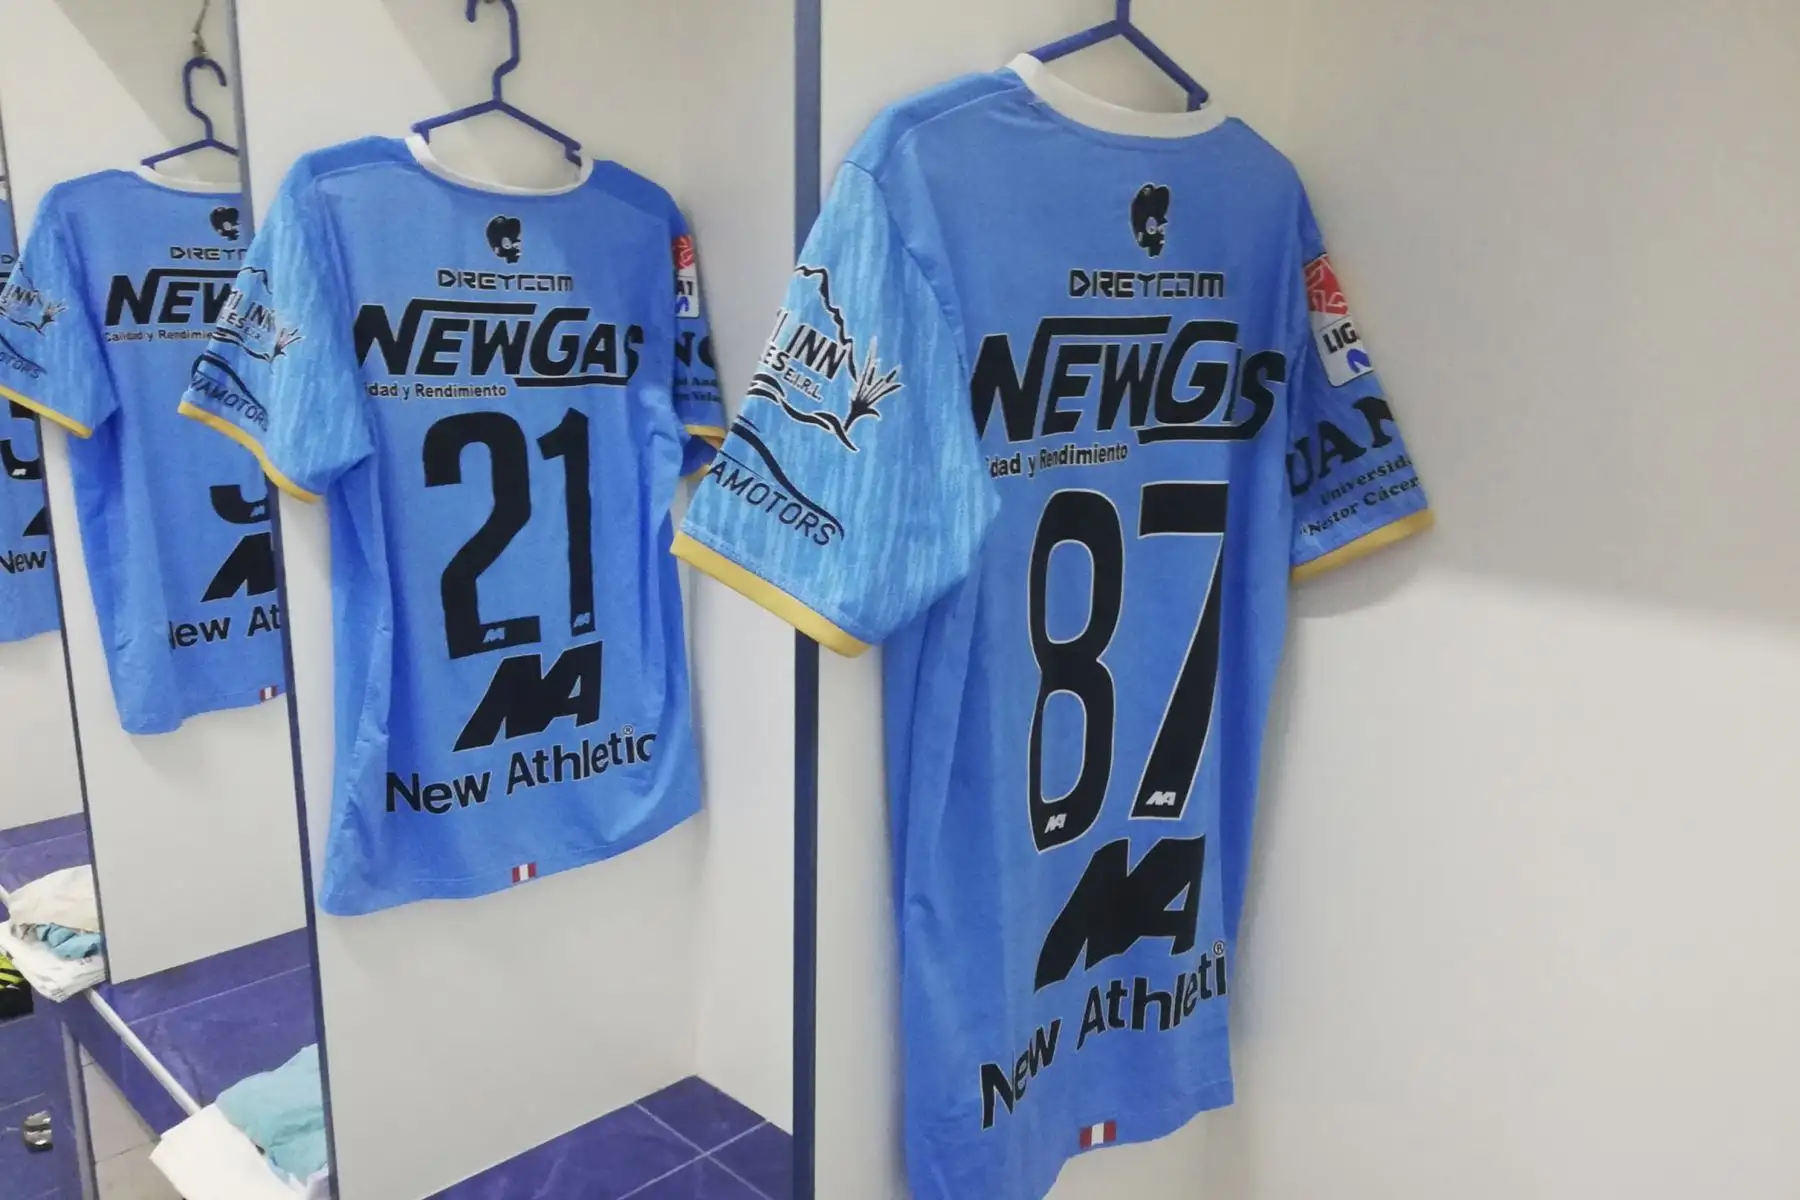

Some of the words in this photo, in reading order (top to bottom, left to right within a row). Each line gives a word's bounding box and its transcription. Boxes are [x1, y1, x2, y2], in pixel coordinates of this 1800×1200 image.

[415, 384, 507, 398] Rendimiento
[786, 323, 847, 380] INN
[970, 315, 1287, 444] NEWGS
[1039, 442, 1128, 470] Rendimiento
[423, 407, 595, 659] 21
[1028, 480, 1229, 854] 87
[386, 770, 492, 815] New
[980, 1017, 1063, 1130] New
